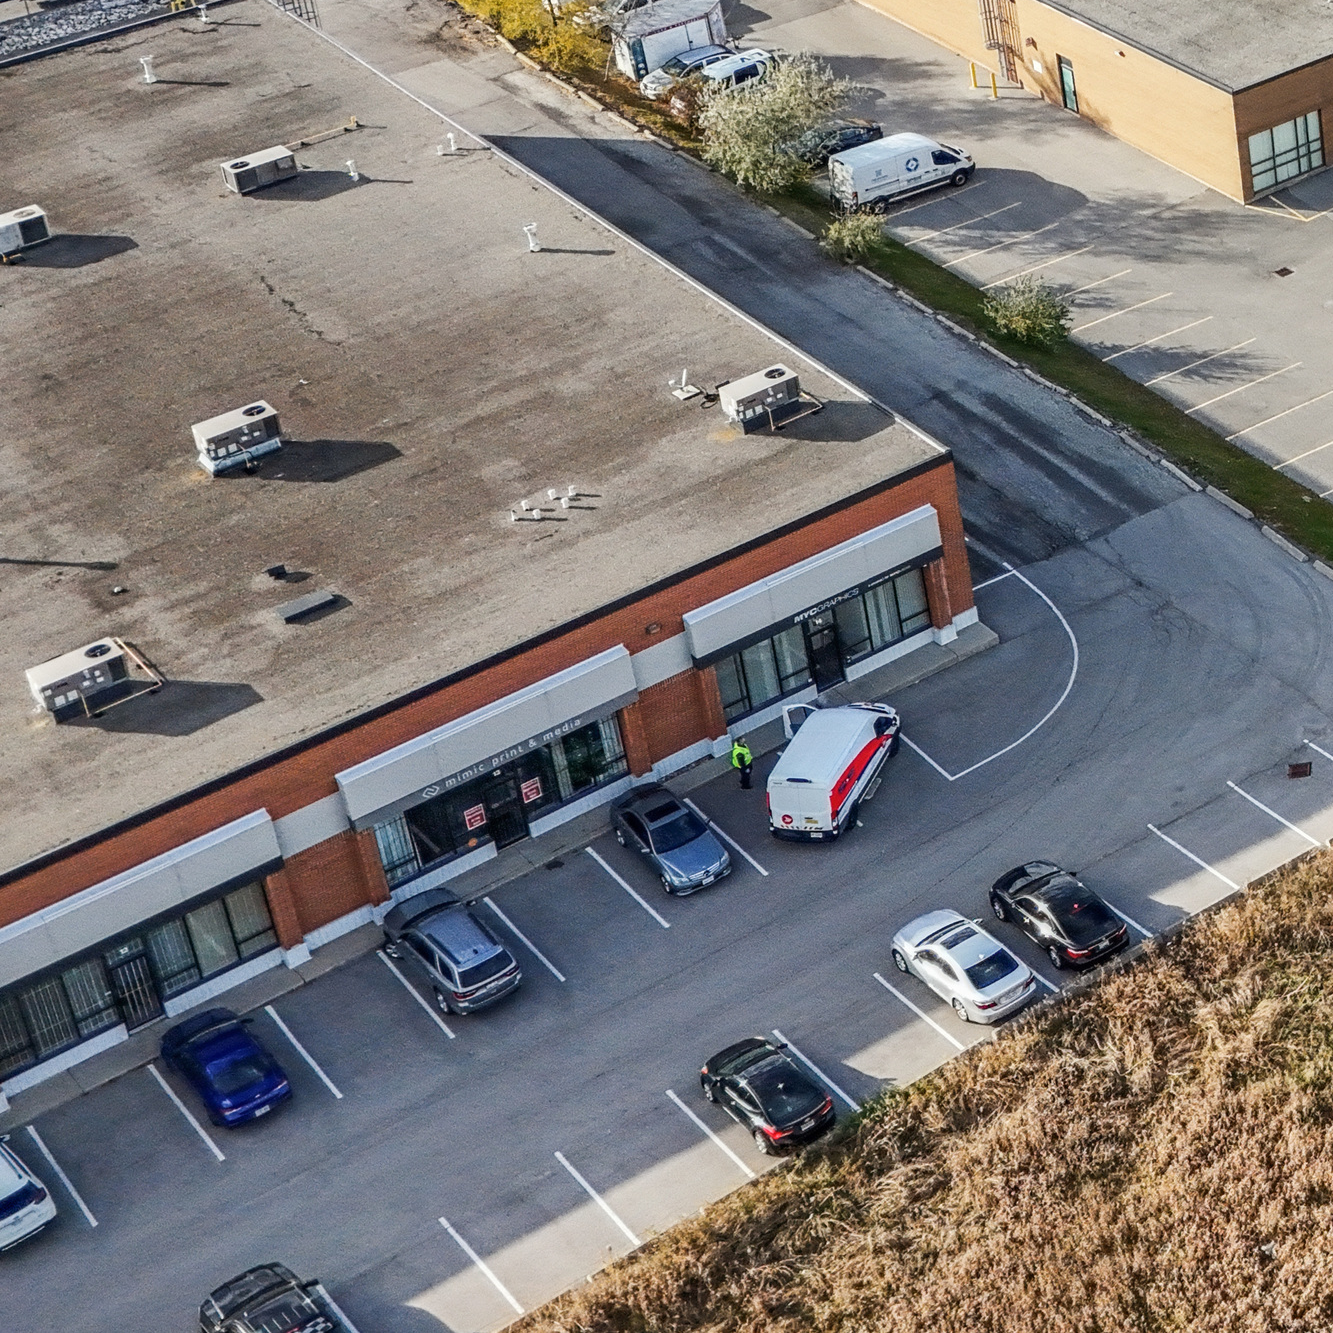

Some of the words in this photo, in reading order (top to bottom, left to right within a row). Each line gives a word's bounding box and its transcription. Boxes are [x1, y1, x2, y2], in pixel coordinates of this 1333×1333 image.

[445, 763, 485, 788] mimic
[491, 745, 524, 767] print
[528, 738, 538, 749] &
[542, 719, 582, 742] media
